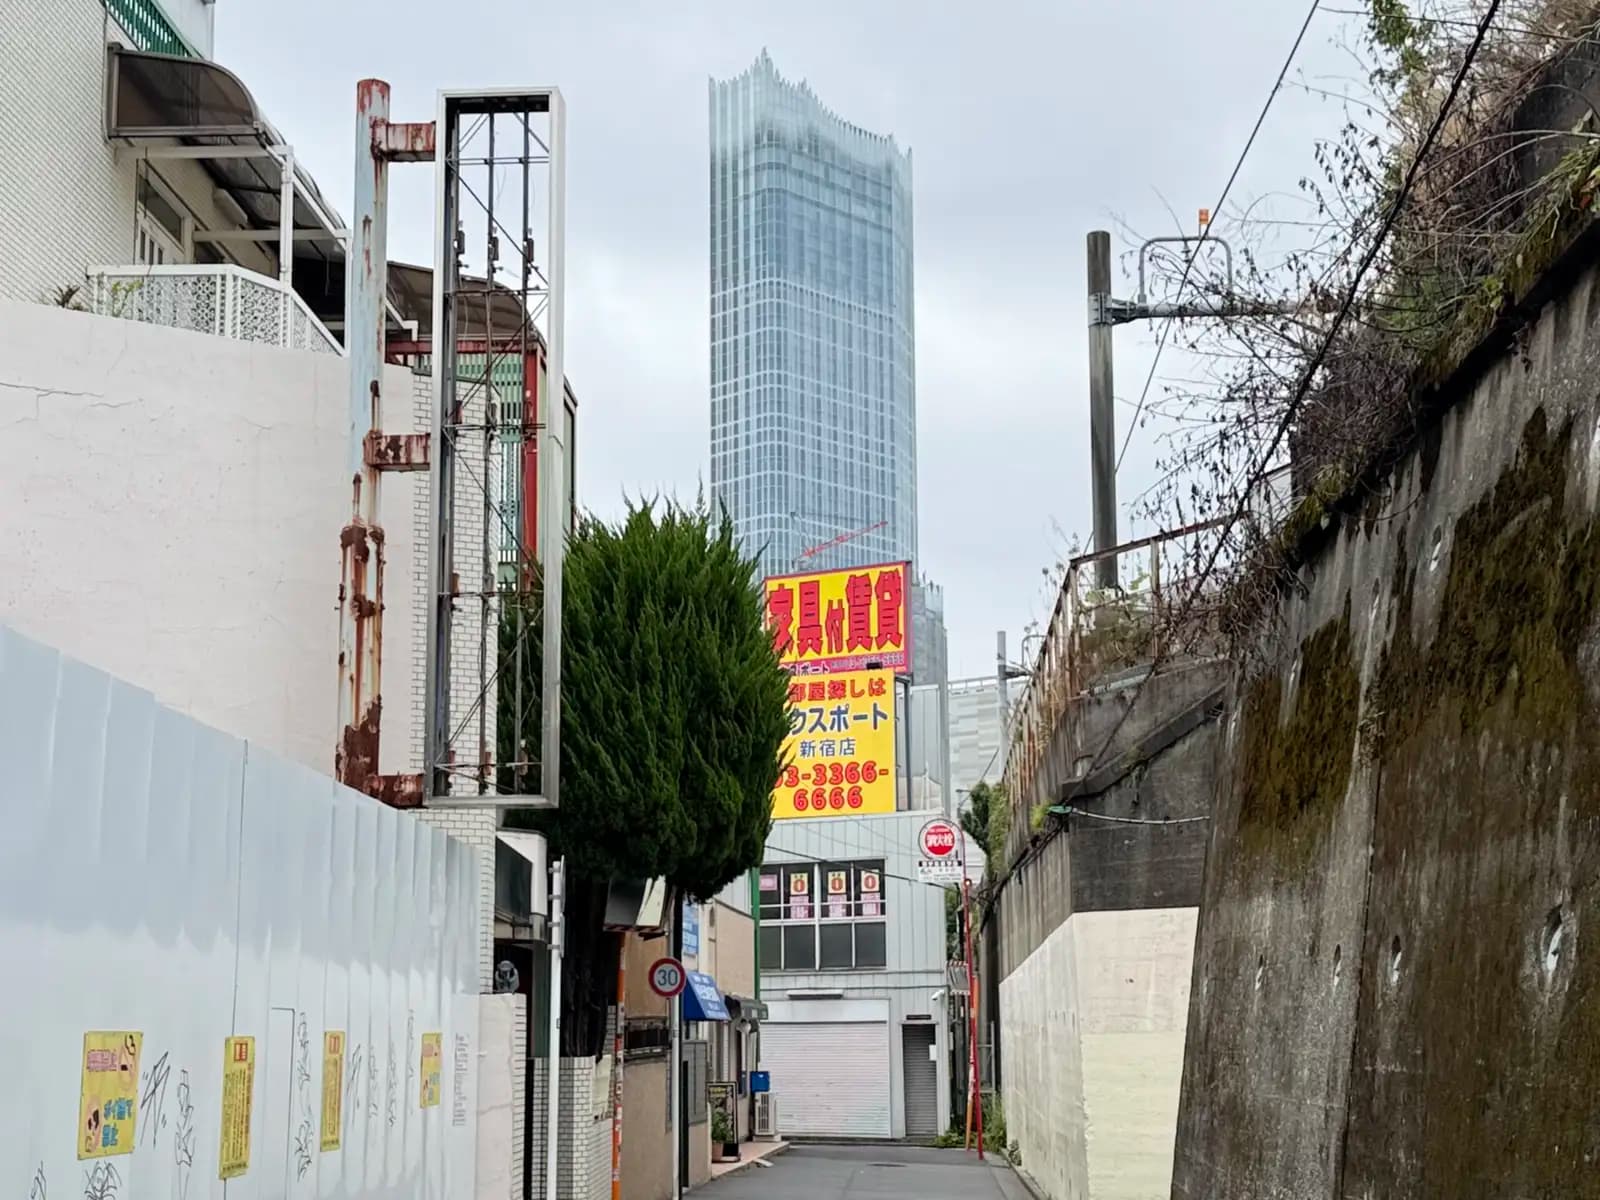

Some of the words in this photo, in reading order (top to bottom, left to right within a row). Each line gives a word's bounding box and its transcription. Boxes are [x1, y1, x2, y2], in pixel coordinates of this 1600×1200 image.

[768, 568, 902, 657] 家具付賃貸
[800, 738, 856, 758] 新宿店
[775, 760, 889, 788] 3-3366-
[793, 785, 863, 811] 6666
[657, 968, 678, 986] 30
